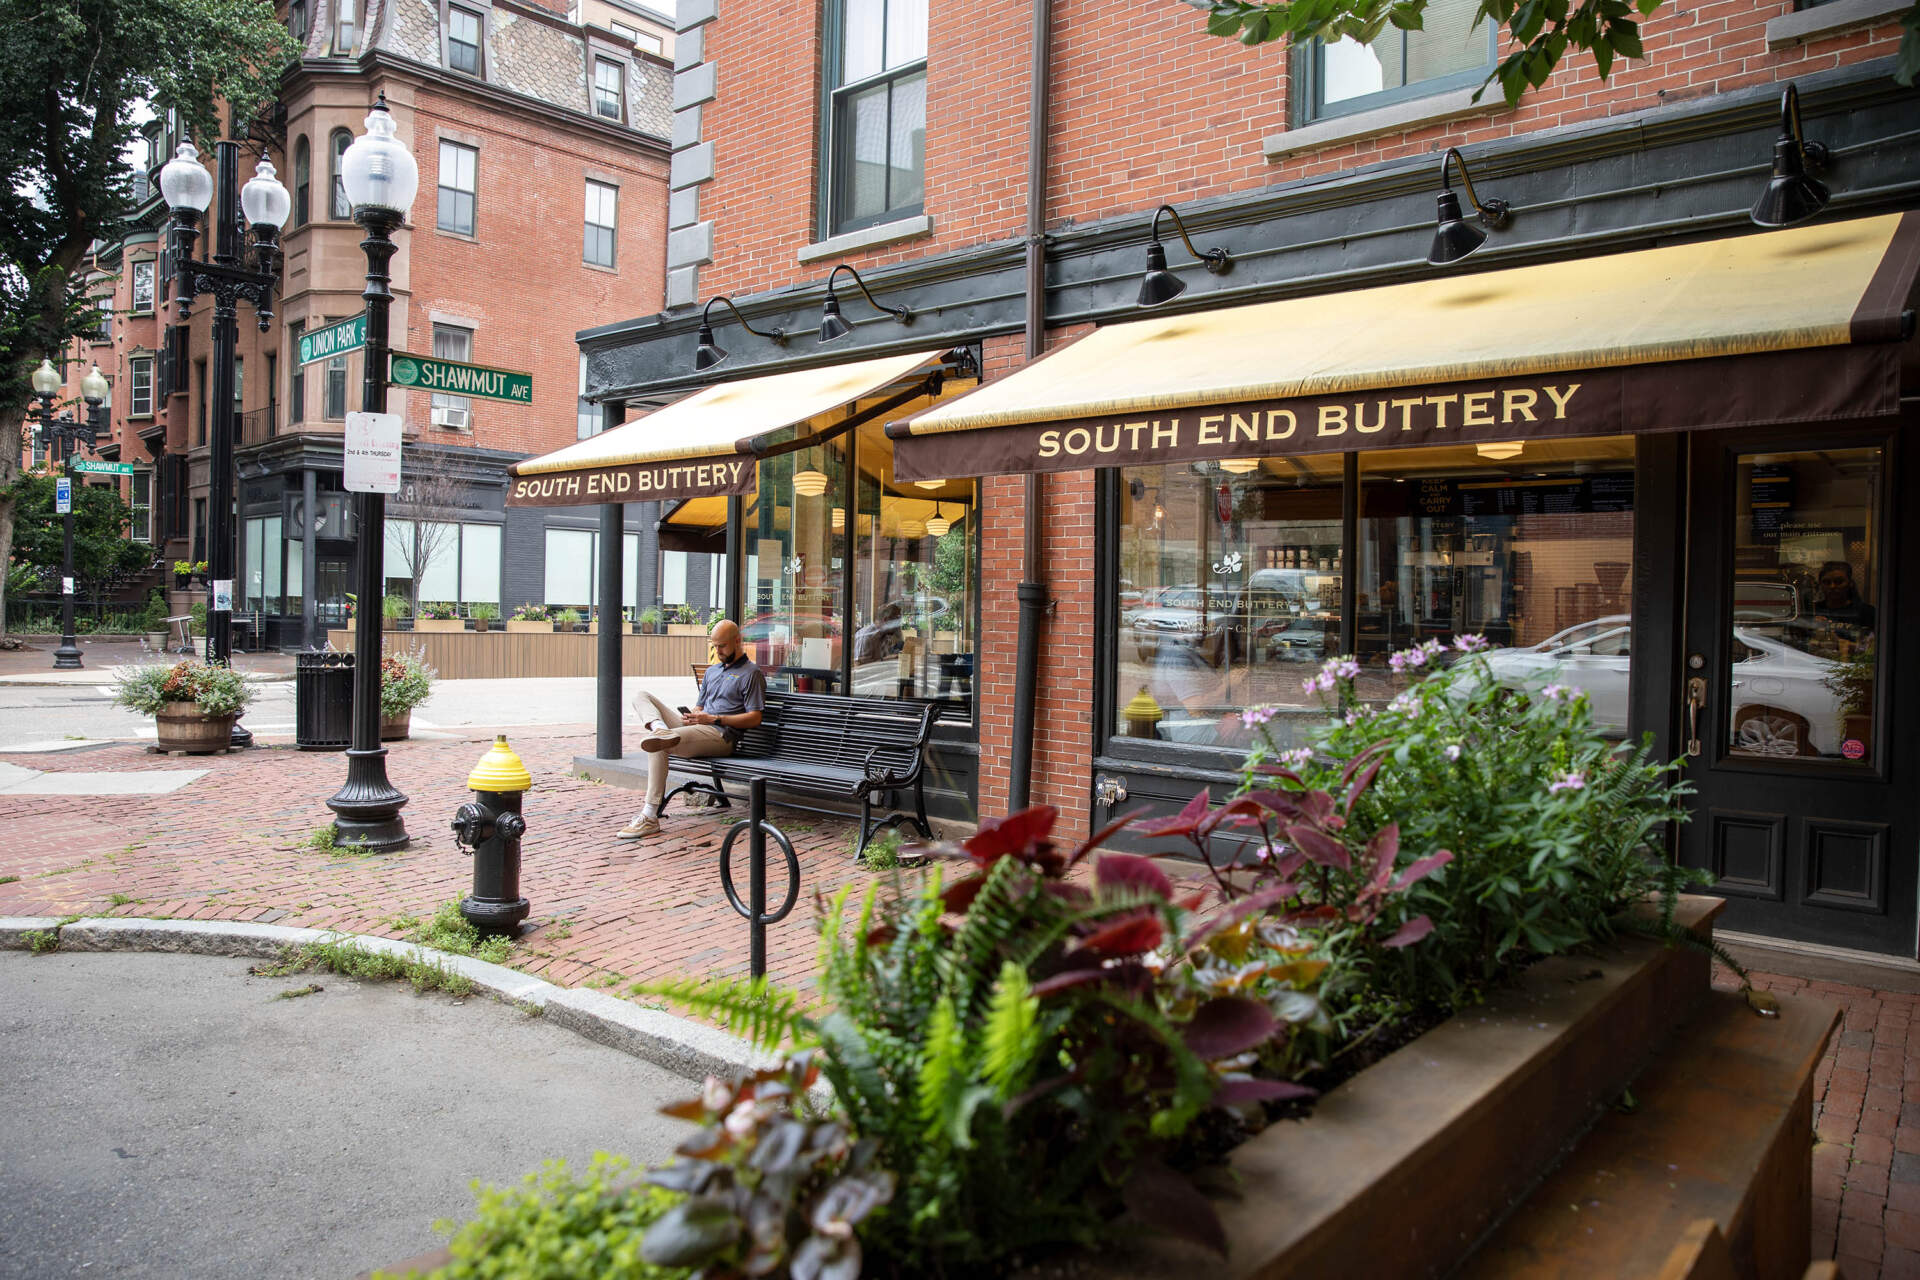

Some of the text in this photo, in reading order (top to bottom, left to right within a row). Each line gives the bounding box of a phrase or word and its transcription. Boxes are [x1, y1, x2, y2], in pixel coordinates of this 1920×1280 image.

[312, 328, 335, 356] UNION
[337, 321, 356, 349] PARK
[421, 362, 529, 399] SHAWMUT AVE
[1038, 383, 1582, 458] SOUTH END BUTTERY
[86, 461, 120, 472] SHAWMUT
[514, 461, 744, 498] SOUTH END BUTTERY
[1419, 496, 1452, 505] CARRY
[1426, 505, 1446, 513] OUT
[1166, 600, 1291, 609] SOUTH END BUTTERY
